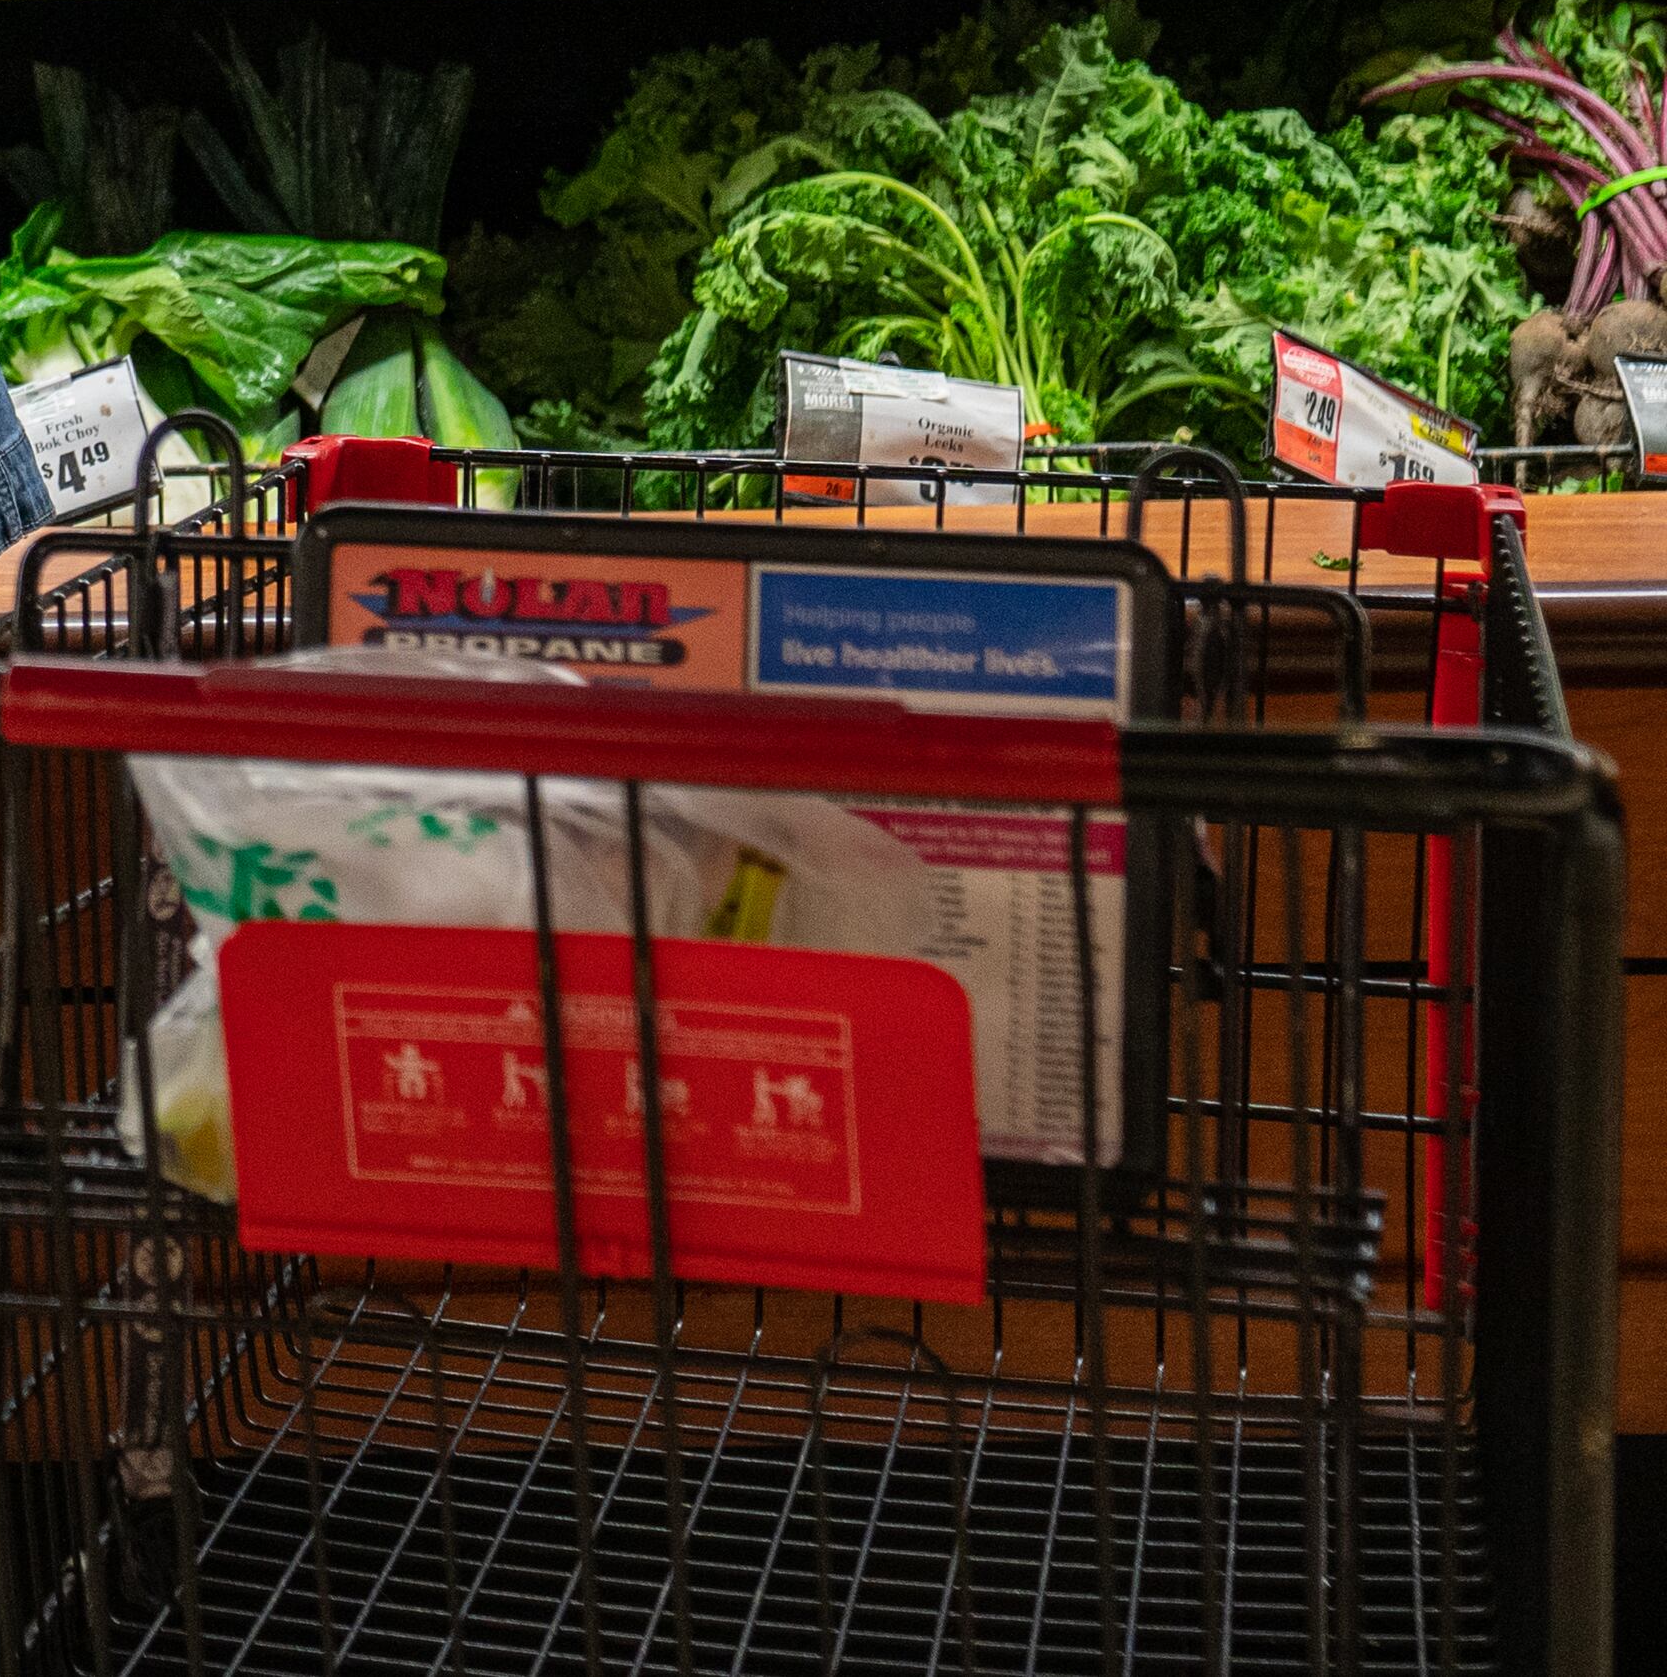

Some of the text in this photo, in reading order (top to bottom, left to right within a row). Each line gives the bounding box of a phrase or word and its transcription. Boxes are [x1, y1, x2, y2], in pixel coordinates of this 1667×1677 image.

[35, 424, 100, 454] Bok Choy
[46, 414, 83, 435] Fresh
[918, 417, 974, 438] Organic
[924, 434, 964, 454] Leeks
[389, 569, 668, 624] NOLAN
[383, 632, 665, 664] PROPANE
[782, 639, 835, 667] live
[841, 641, 976, 674] healthier
